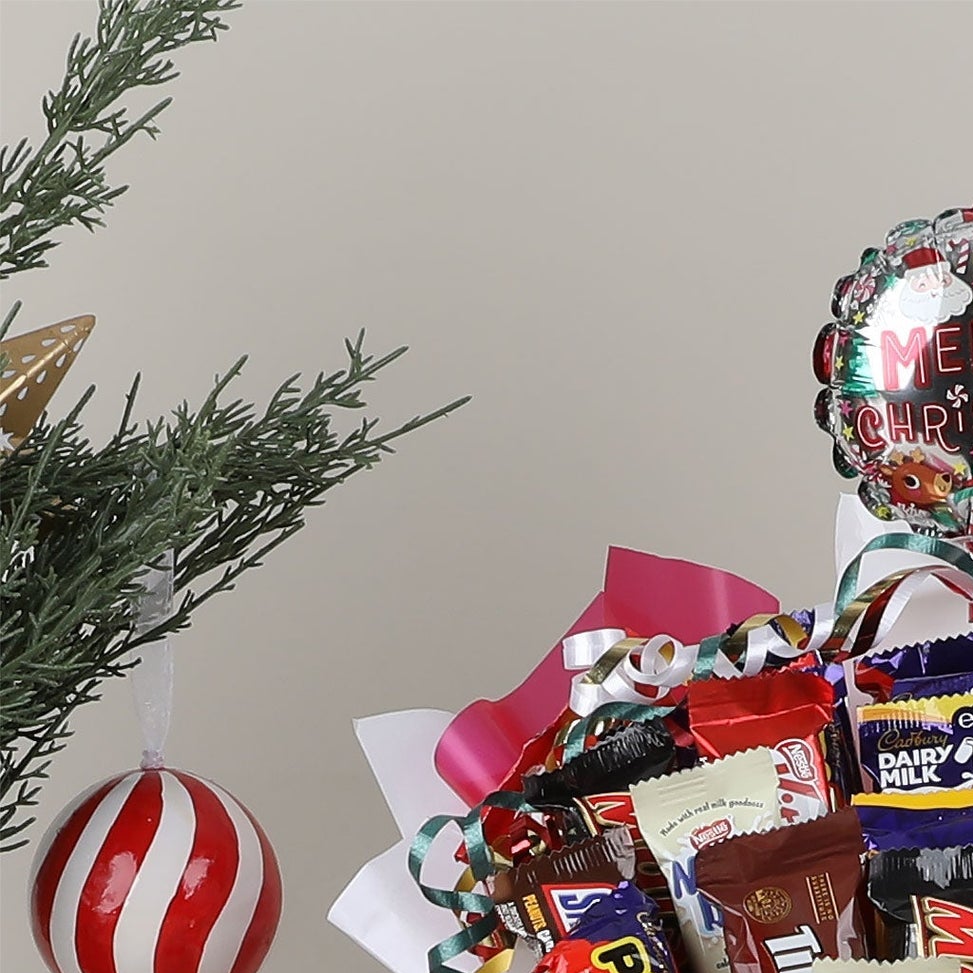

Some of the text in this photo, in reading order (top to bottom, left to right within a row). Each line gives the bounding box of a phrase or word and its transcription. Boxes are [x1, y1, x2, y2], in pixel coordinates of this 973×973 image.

[878, 729, 949, 751] Cadbury
[878, 744, 953, 769] DAIRY
[881, 765, 941, 788] MILK
[678, 809, 694, 822] with
[711, 799, 727, 809] milk
